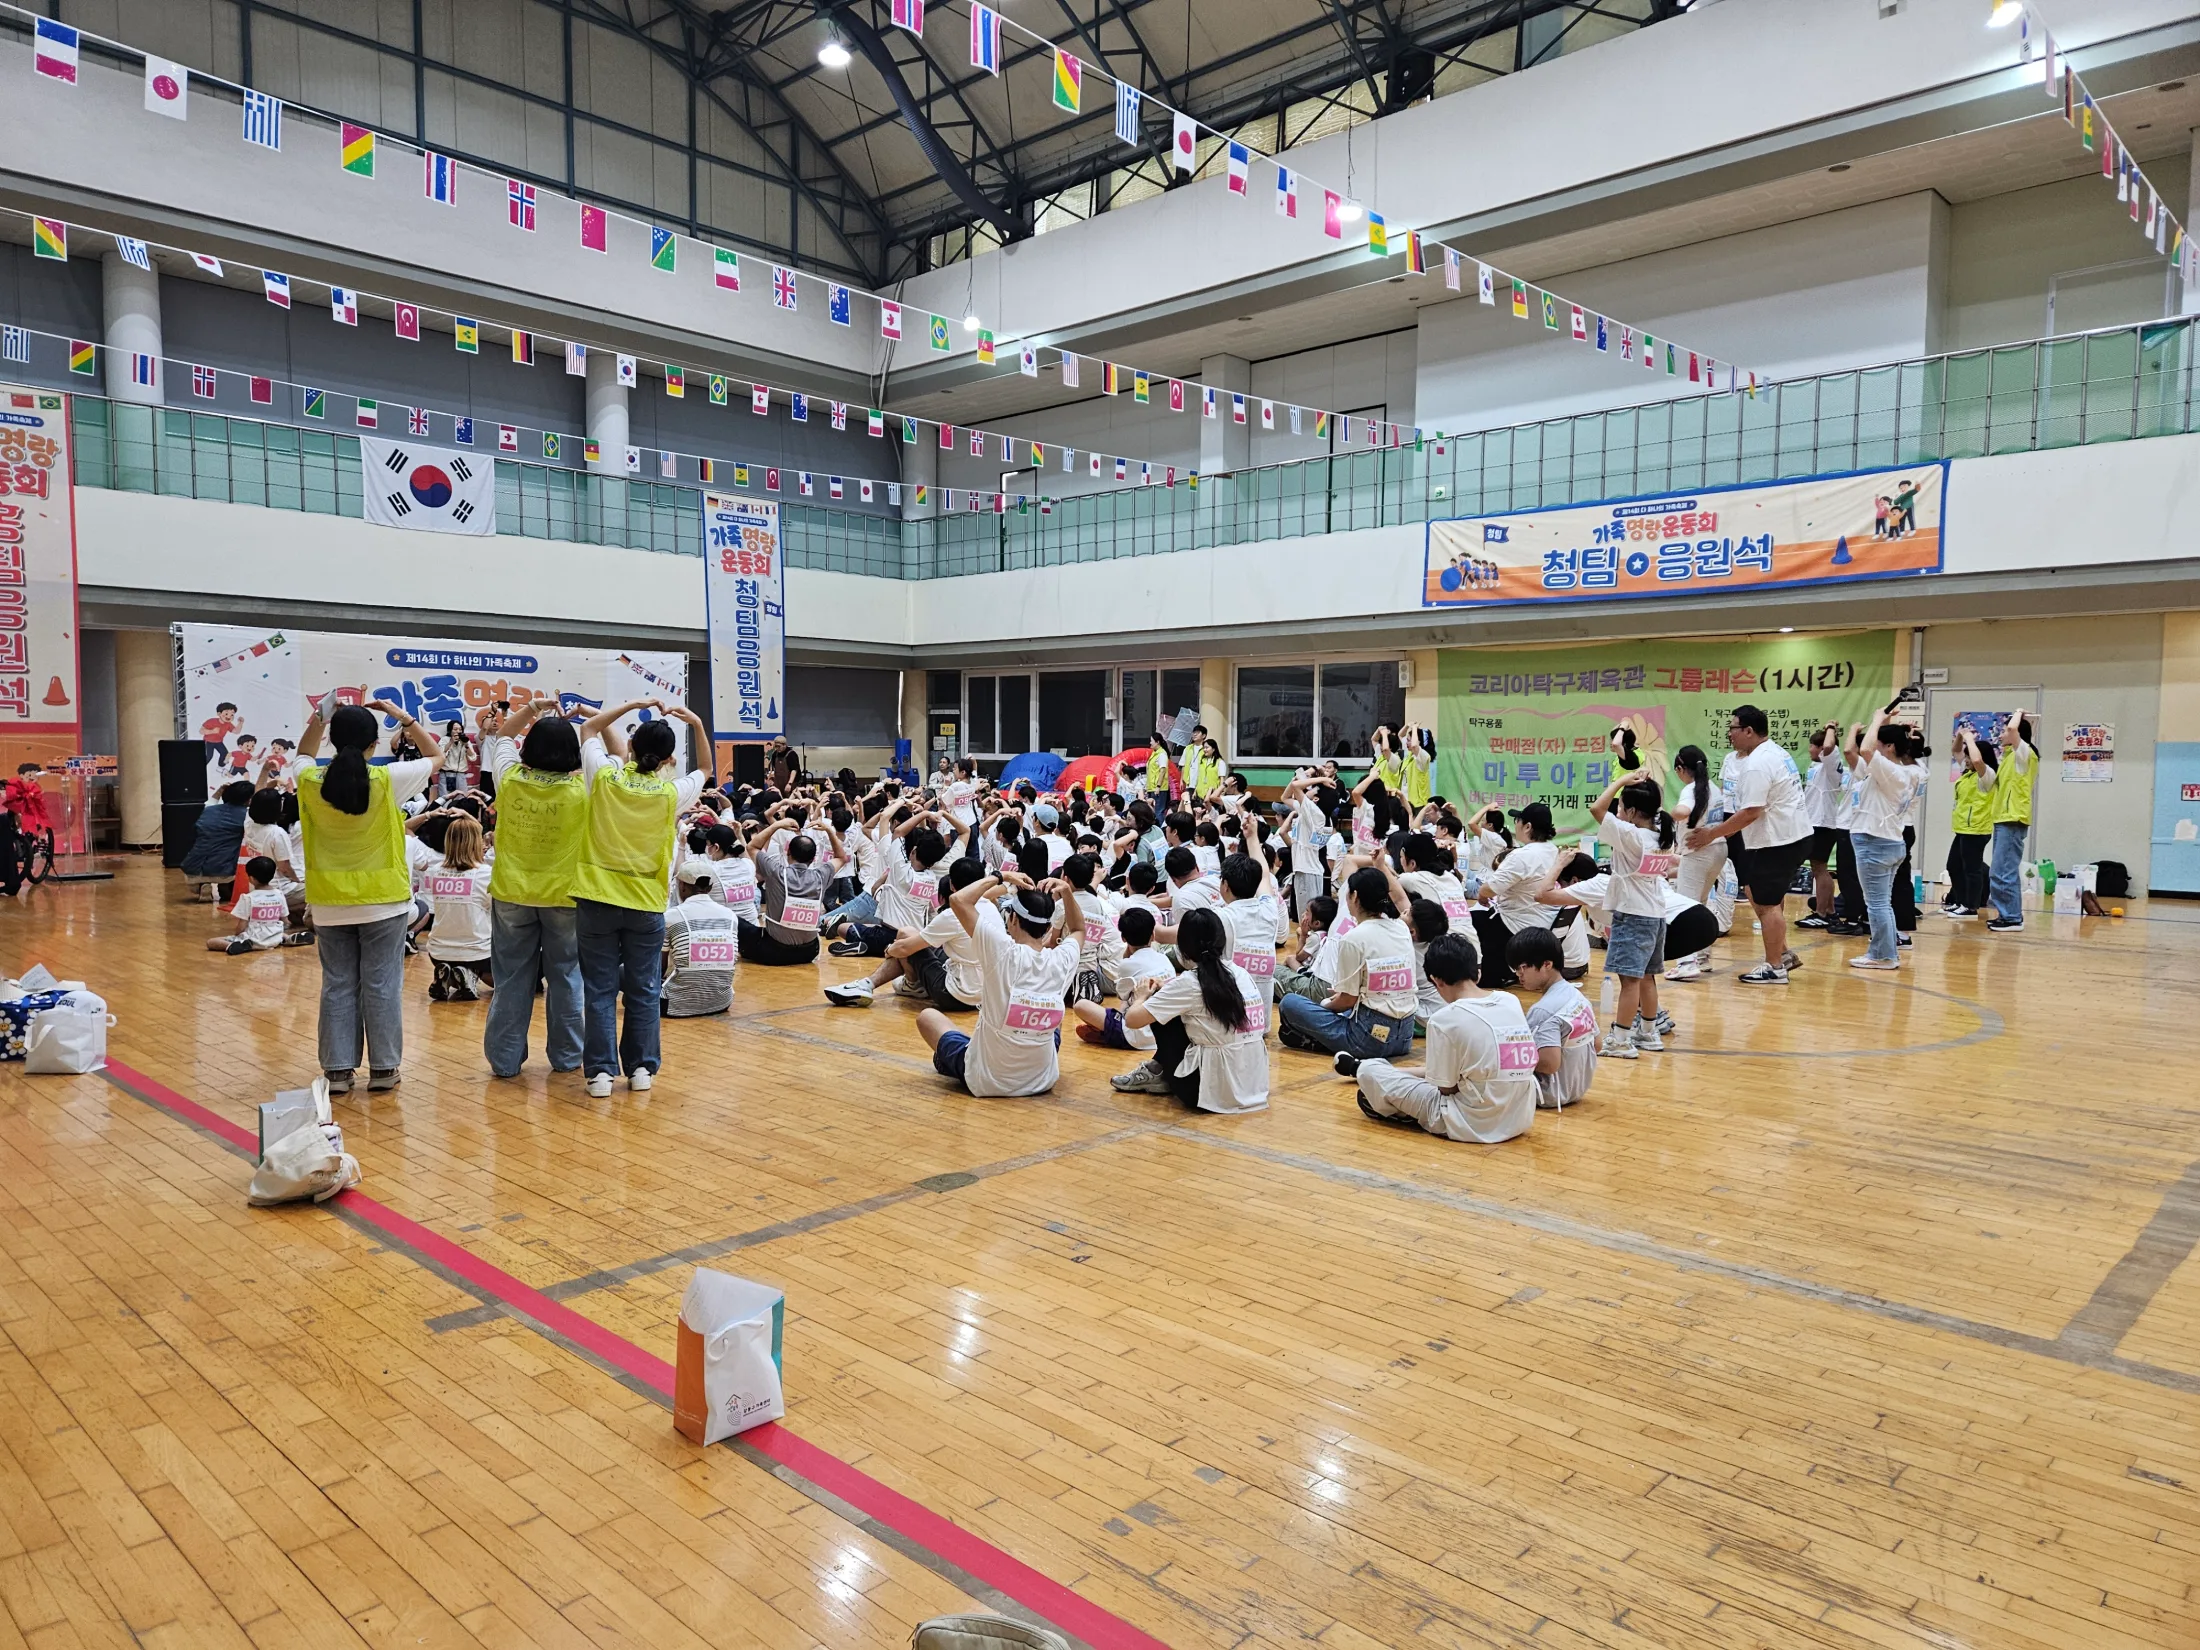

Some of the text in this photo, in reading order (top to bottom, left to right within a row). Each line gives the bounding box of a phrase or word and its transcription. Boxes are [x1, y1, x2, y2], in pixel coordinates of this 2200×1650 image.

[720, 548, 771, 577] 운동회
[1542, 533, 1774, 588] 청팀 응원석
[406, 653, 522, 669] 제14회 다 하나의 가족축제
[1469, 664, 1647, 696] 코리아탁구체육관
[1469, 718, 1502, 728] 탁구용품
[1802, 719, 1820, 728] 위주
[1489, 736, 1607, 755] 판매점(자) 모집
[1538, 794, 1579, 809] 직거래
[1649, 858, 1669, 872] 170
[436, 880, 465, 893] 008
[918, 885, 933, 897] 106
[733, 889, 752, 900] 114
[258, 907, 280, 919] 004
[790, 909, 814, 923] 108
[1451, 903, 1469, 915] 152
[698, 946, 728, 959] 052
[1242, 956, 1268, 973] 156
[1380, 972, 1407, 988] 160
[1020, 1010, 1051, 1028] 164
[1511, 1046, 1538, 1066] 162
